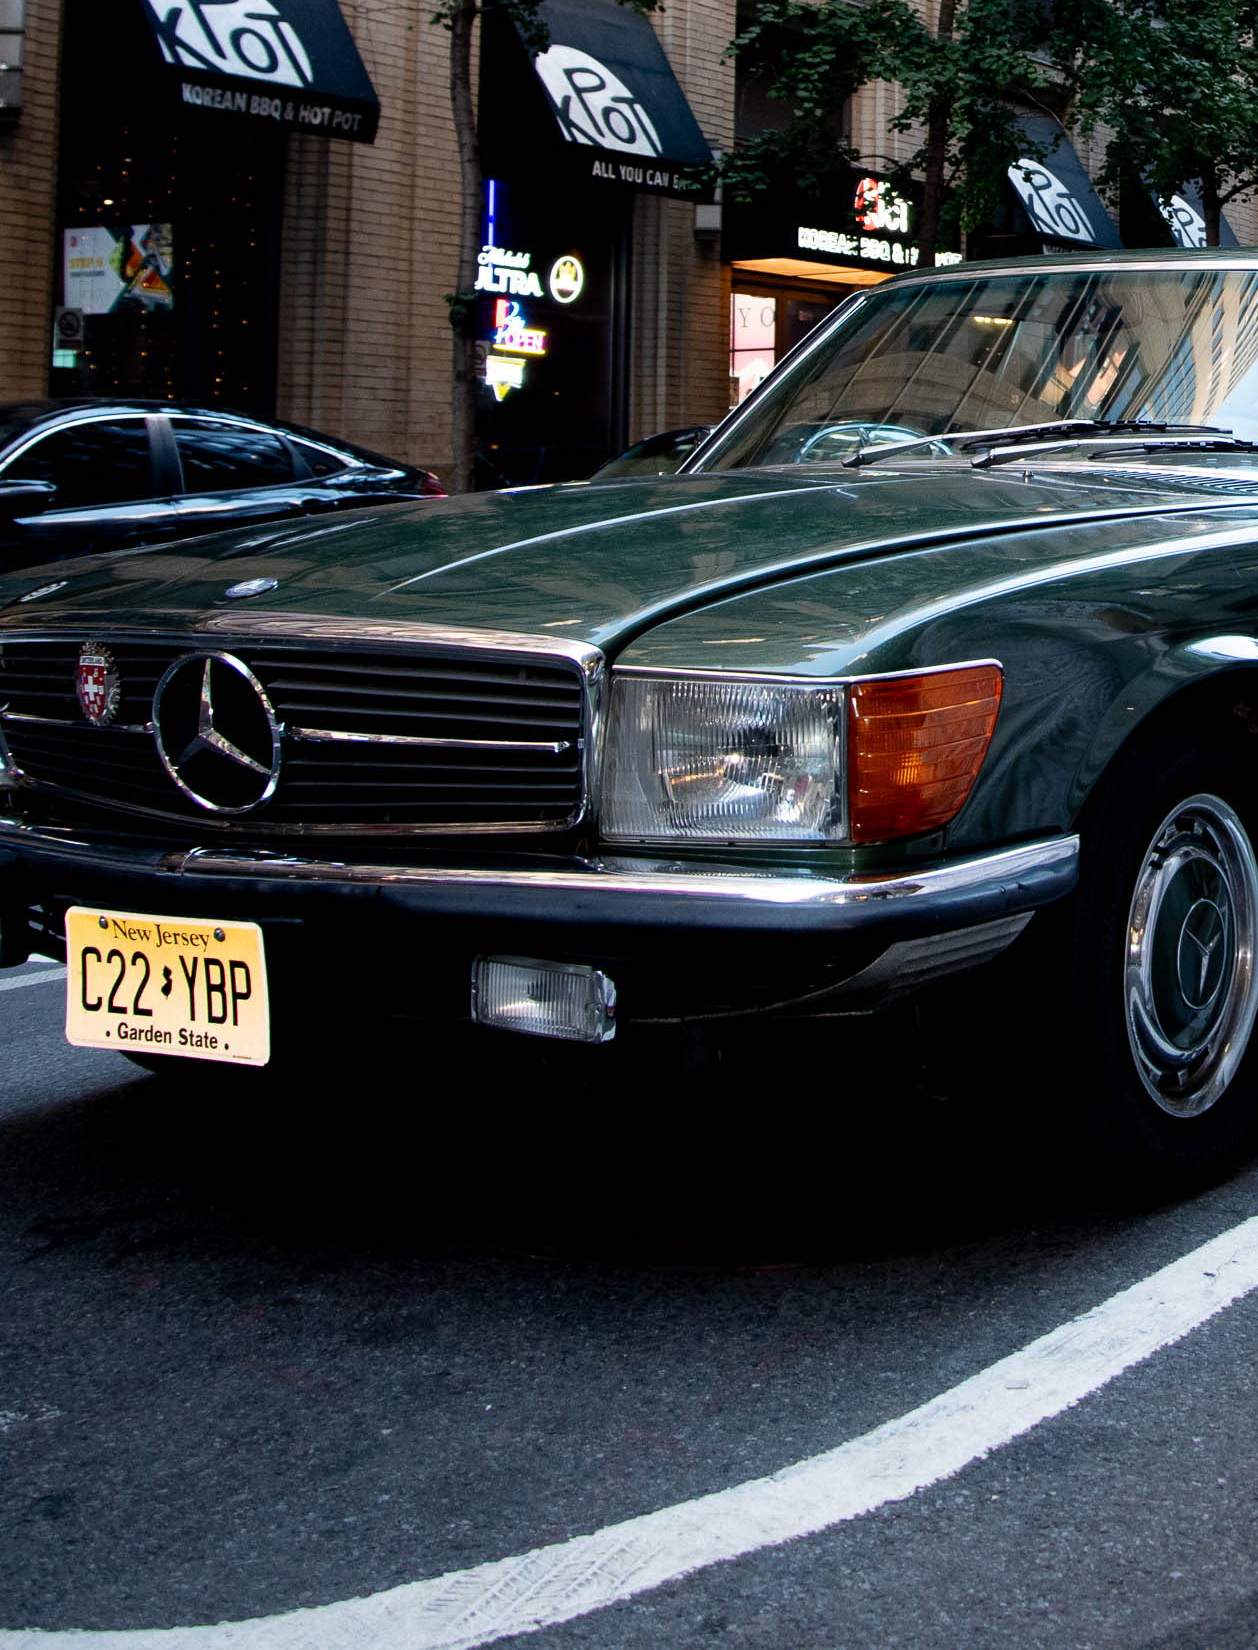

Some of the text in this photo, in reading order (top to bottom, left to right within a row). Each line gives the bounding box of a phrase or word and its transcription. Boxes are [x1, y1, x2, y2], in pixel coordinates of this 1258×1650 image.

[181, 83, 362, 131] KOREAN BBQ & HOT POT
[592, 160, 616, 179] ALL
[619, 165, 644, 183] YOU
[646, 169, 670, 188] CAN
[860, 237, 891, 261] BBQ
[111, 919, 210, 952] New Jersey
[81, 946, 252, 1027] C22 YBP
[117, 1021, 219, 1050] Garden State
